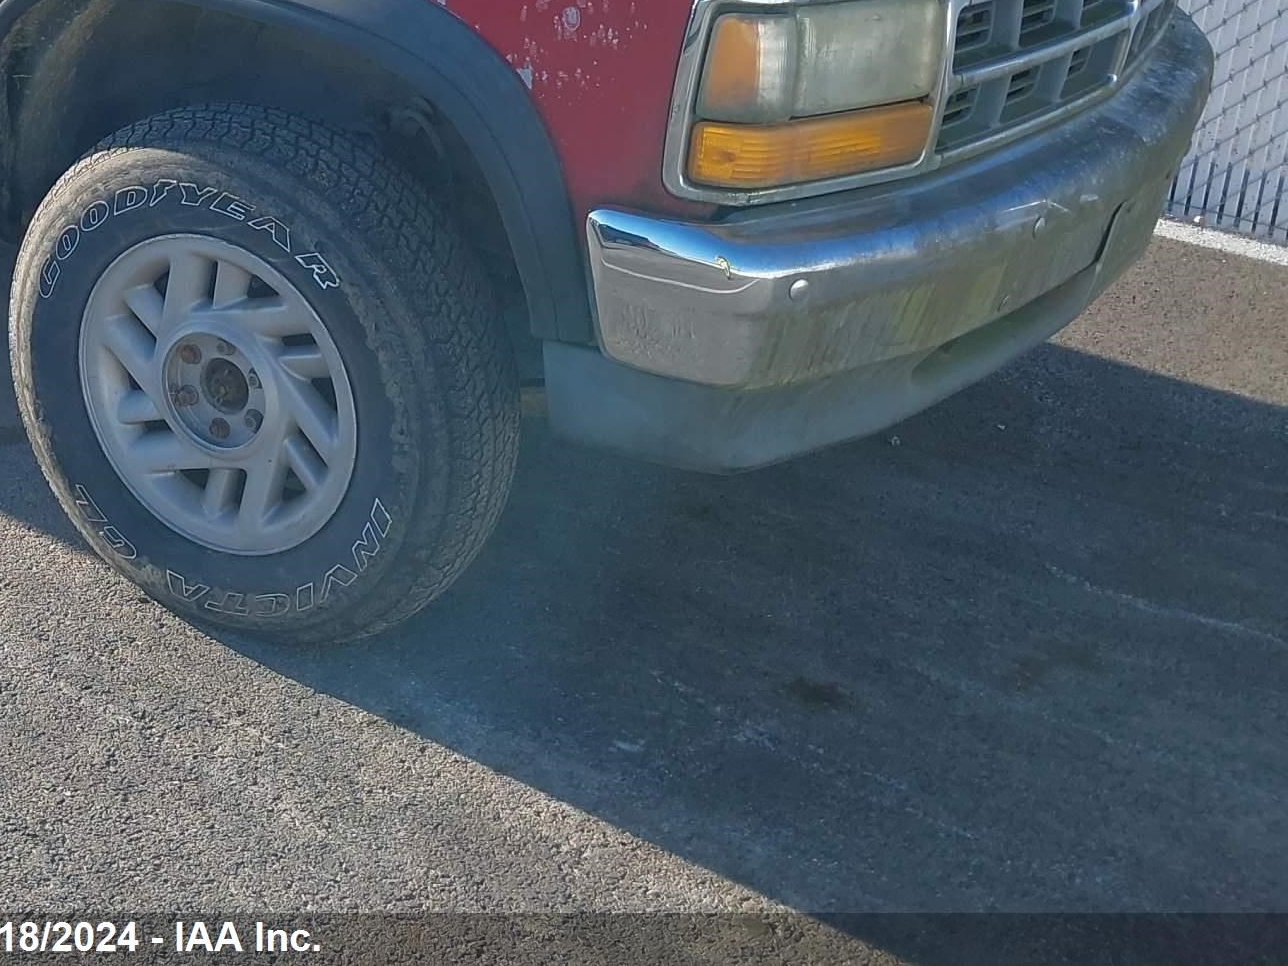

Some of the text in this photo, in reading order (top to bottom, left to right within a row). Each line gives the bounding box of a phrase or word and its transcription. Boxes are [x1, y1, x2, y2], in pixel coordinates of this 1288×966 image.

[38, 178, 341, 300] GOODYEAR
[75, 483, 393, 618] INVICTA GL
